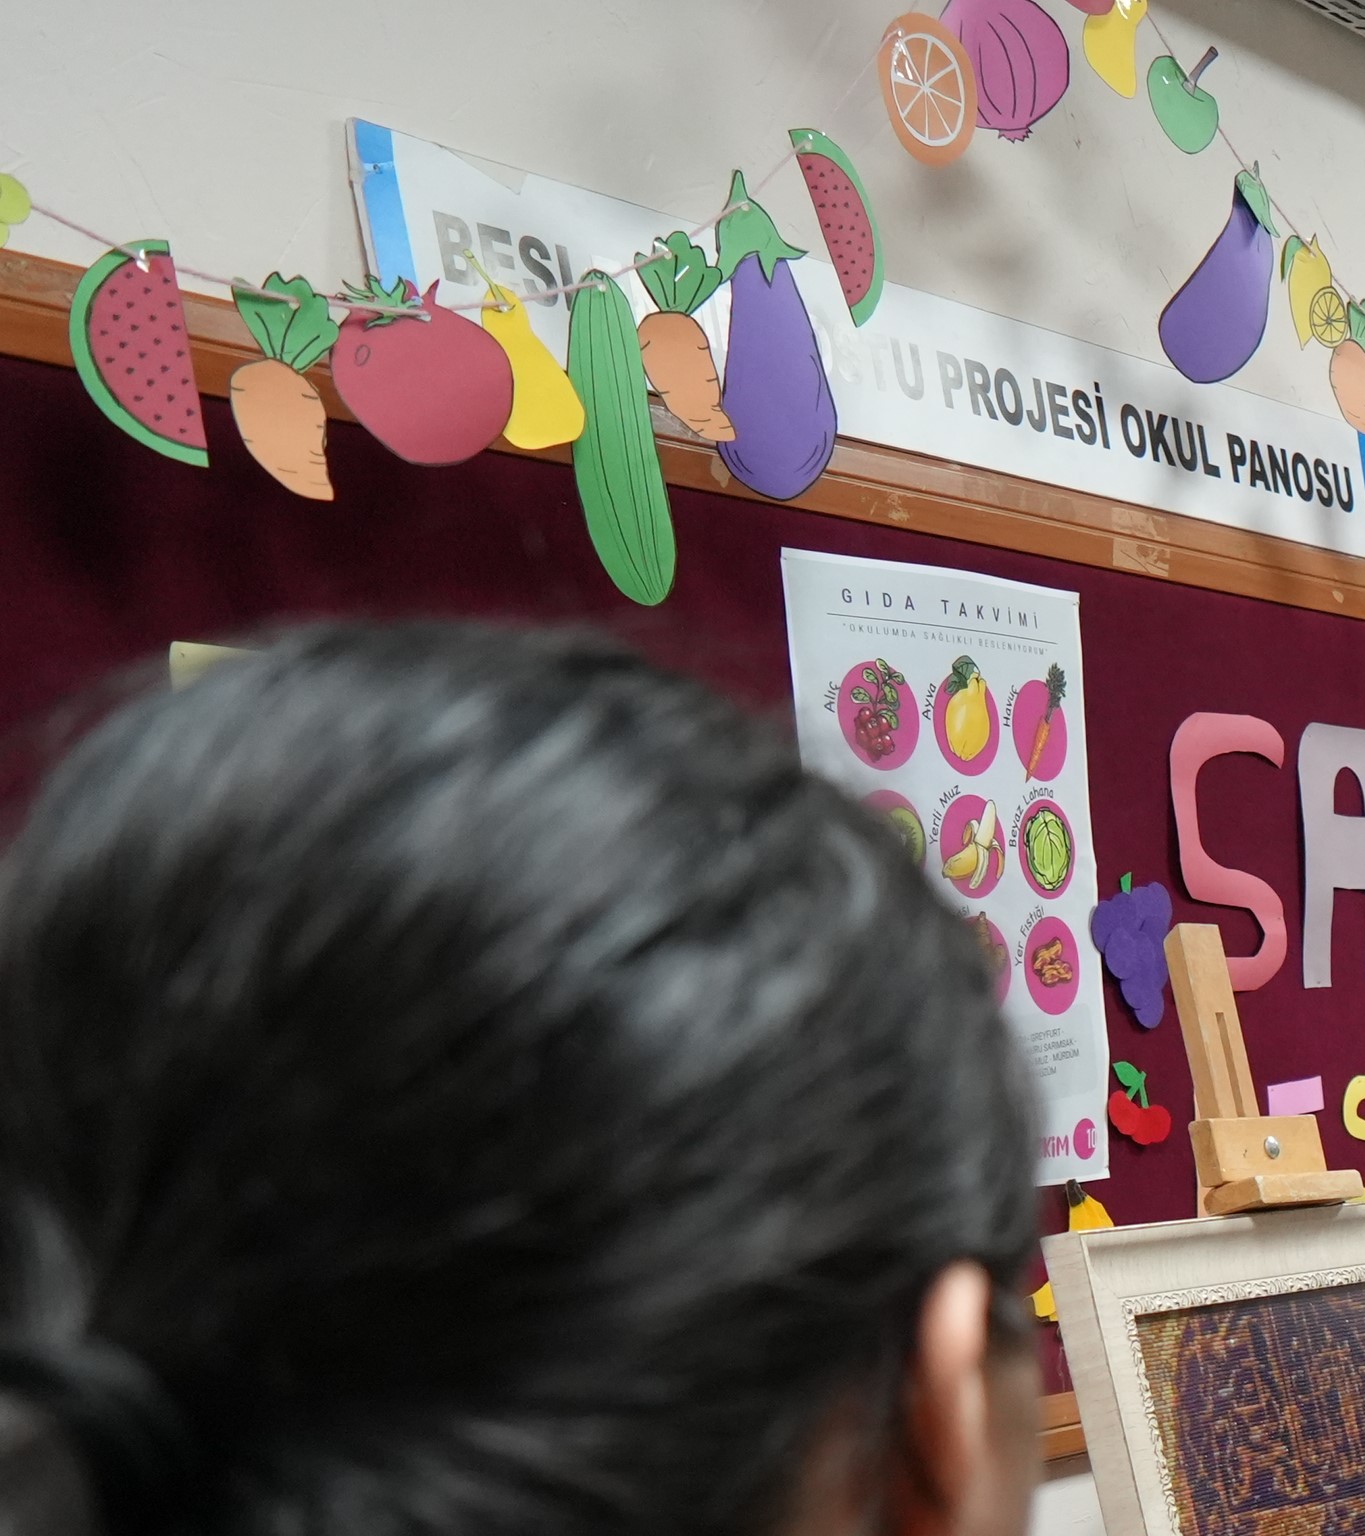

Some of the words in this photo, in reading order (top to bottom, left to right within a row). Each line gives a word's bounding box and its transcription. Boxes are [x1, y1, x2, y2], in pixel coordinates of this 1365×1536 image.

[937, 349, 1110, 449] PROJESİ
[1121, 402, 1222, 478] OKUL
[1225, 432, 1354, 513] PANOSU
[841, 588, 915, 611] GIDA
[941, 599, 1038, 629] TAKVİMİ
[824, 681, 841, 713] Alıç
[922, 682, 937, 720] Ayva
[1003, 685, 1019, 727] Havuç
[929, 808, 942, 845] Yerli
[939, 785, 961, 808] Muz
[1009, 806, 1024, 847] Beyaz
[1023, 786, 1054, 804] Lahana
[1014, 941, 1025, 966] Yer
